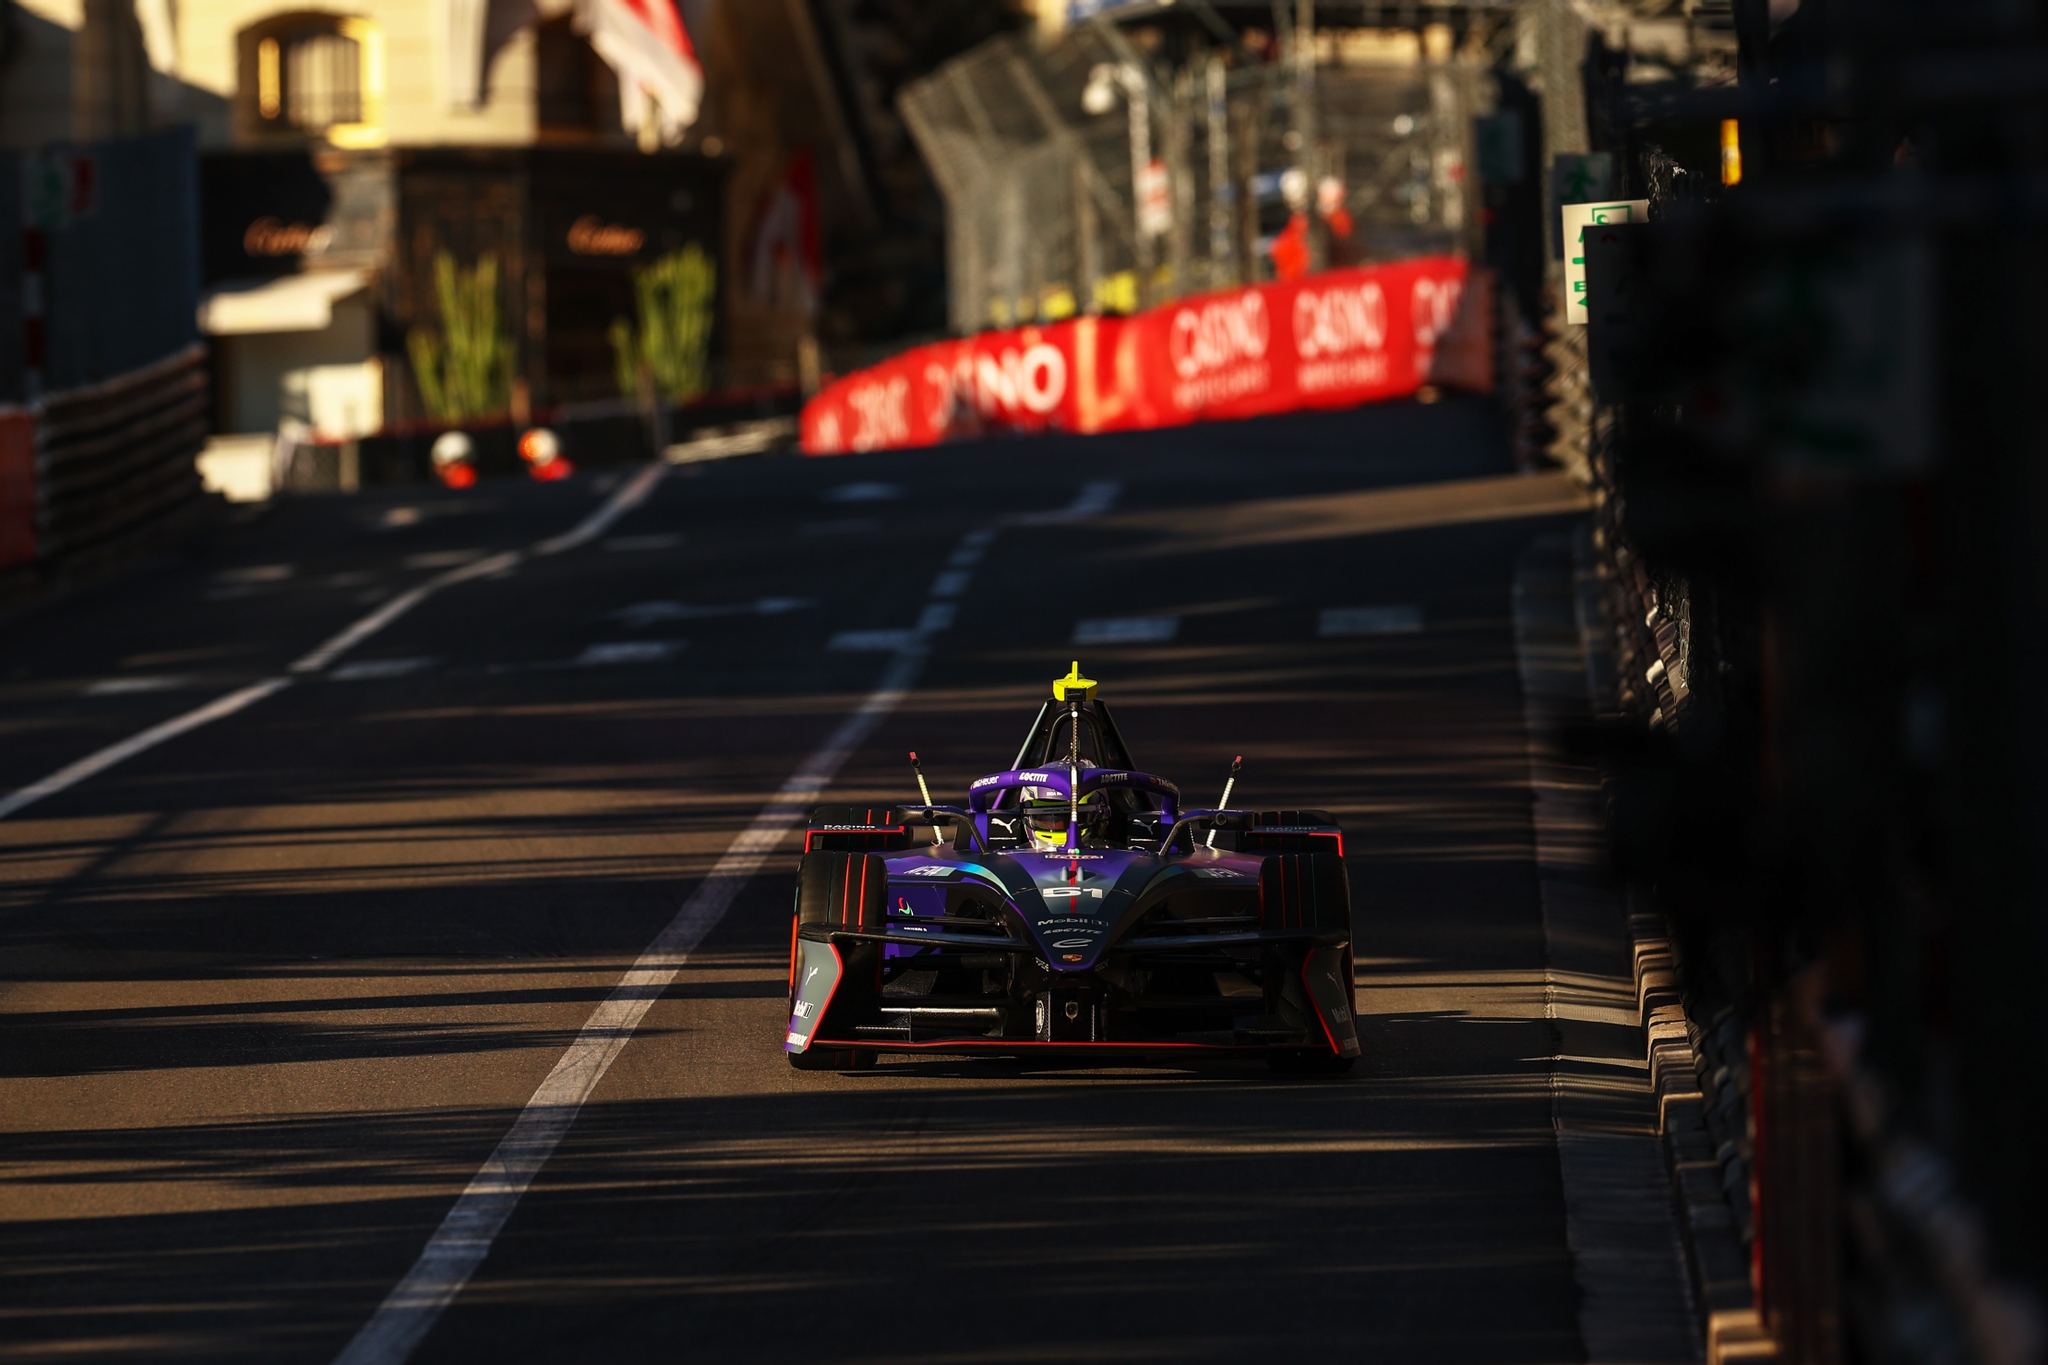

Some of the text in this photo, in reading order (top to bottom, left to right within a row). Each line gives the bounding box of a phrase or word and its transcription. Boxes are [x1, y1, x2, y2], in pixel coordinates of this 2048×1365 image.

[1018, 772, 1049, 782] LOCTITE
[1100, 773, 1128, 783] LOCTITE
[1042, 886, 1102, 899] 51
[1037, 917, 1088, 927] Mobil
[1042, 927, 1103, 935] LOCTITE
